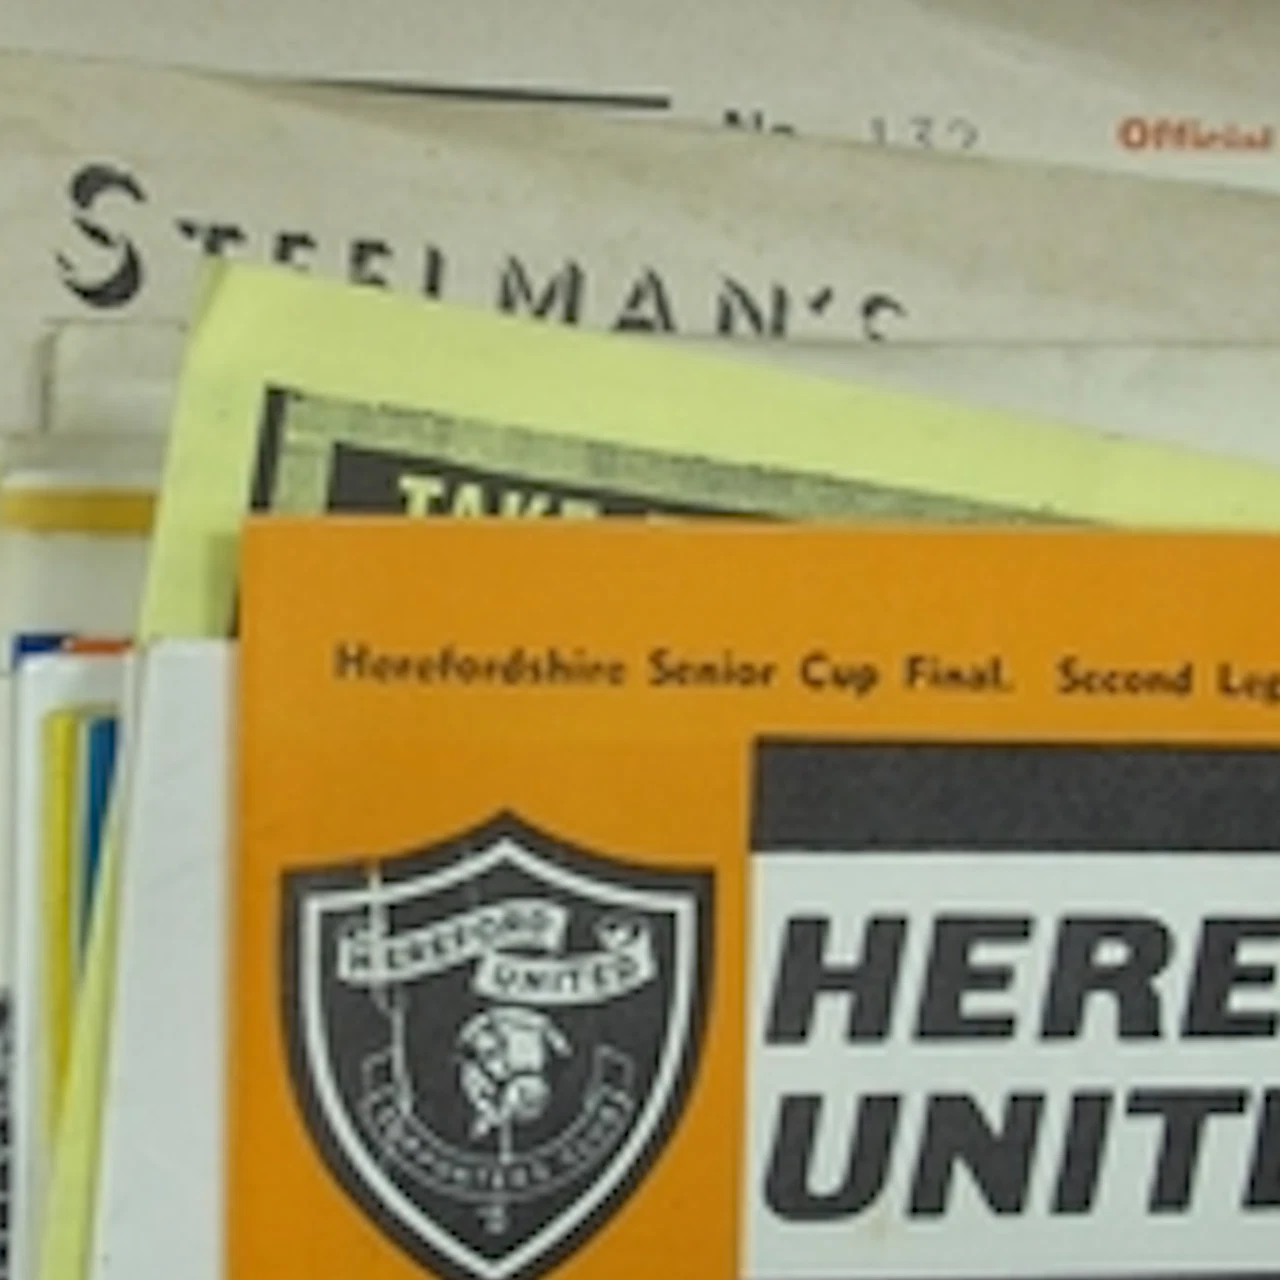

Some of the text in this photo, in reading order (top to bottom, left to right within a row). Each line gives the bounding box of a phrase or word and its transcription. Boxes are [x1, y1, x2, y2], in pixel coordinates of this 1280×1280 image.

[1118, 117, 1273, 150] Official
[335, 644, 626, 686] Herefordshire
[648, 648, 777, 688] Senior
[800, 651, 879, 697] Cup
[906, 654, 1013, 692] Final.
[1058, 656, 1193, 696] Second
